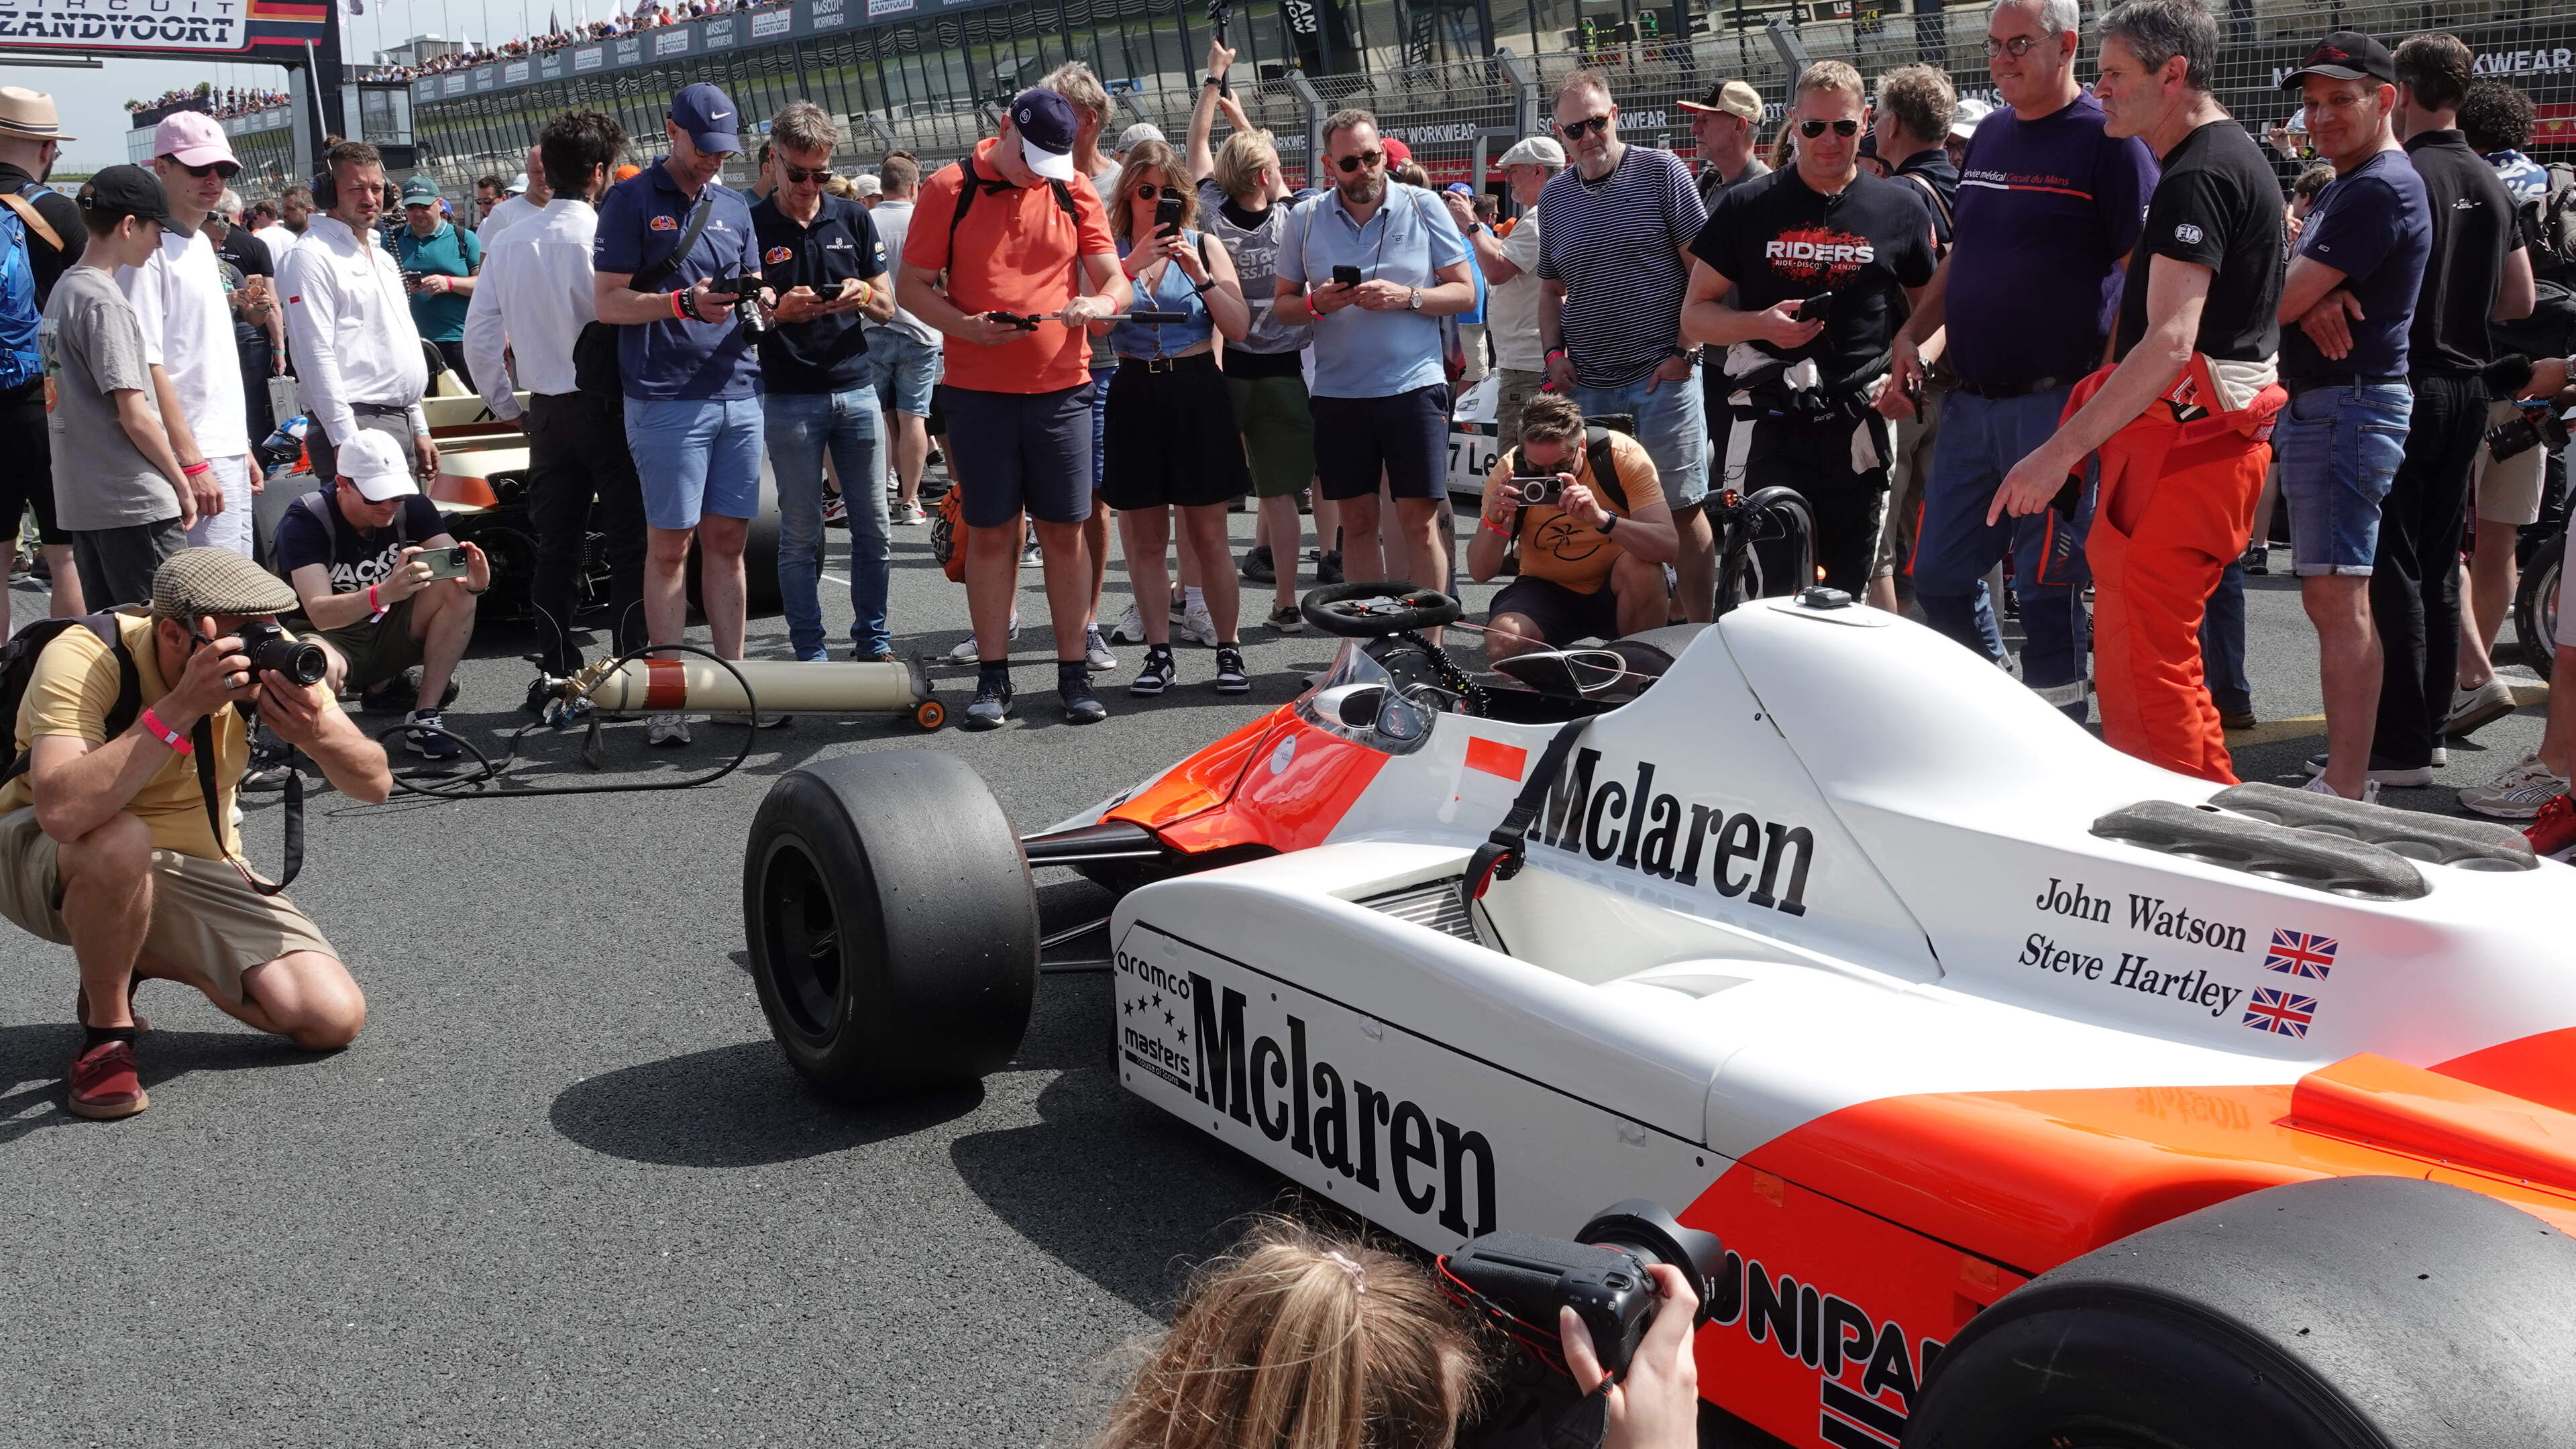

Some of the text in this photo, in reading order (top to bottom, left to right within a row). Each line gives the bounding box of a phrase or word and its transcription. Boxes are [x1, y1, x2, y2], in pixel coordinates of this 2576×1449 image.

[0, 0, 234, 13] IRCUIT
[0, 11, 234, 42] ZANDVOORT
[813, 13, 844, 29] WORKWEAR
[706, 34, 733, 49] WORKWEAR
[2472, 48, 2573, 78] KWEAR
[1961, 88, 2006, 109] MAS
[1616, 110, 1668, 129] KWEAR
[1273, 134, 1306, 150] ORKWE
[1407, 123, 1477, 144] WORKWEAR
[1980, 170, 2006, 182] médical
[2006, 172, 2031, 183] Circuit
[2031, 174, 2043, 184] du
[2045, 175, 2070, 186] Mans
[2177, 226, 2200, 241] FIA
[1766, 240, 1874, 264] RIDERS
[1774, 259, 1793, 267] RIDE
[1838, 263, 1862, 271] ENJOY
[1526, 739, 1814, 917] Mclaren
[2036, 877, 2247, 953] John Watson
[1118, 950, 1190, 1000] aramco
[2018, 932, 2243, 1017] Steve Hartley
[1124, 1026, 1190, 1077] masters
[1188, 970, 1497, 1239] Mclaren
[1709, 1249, 1945, 1411] UNIPA
